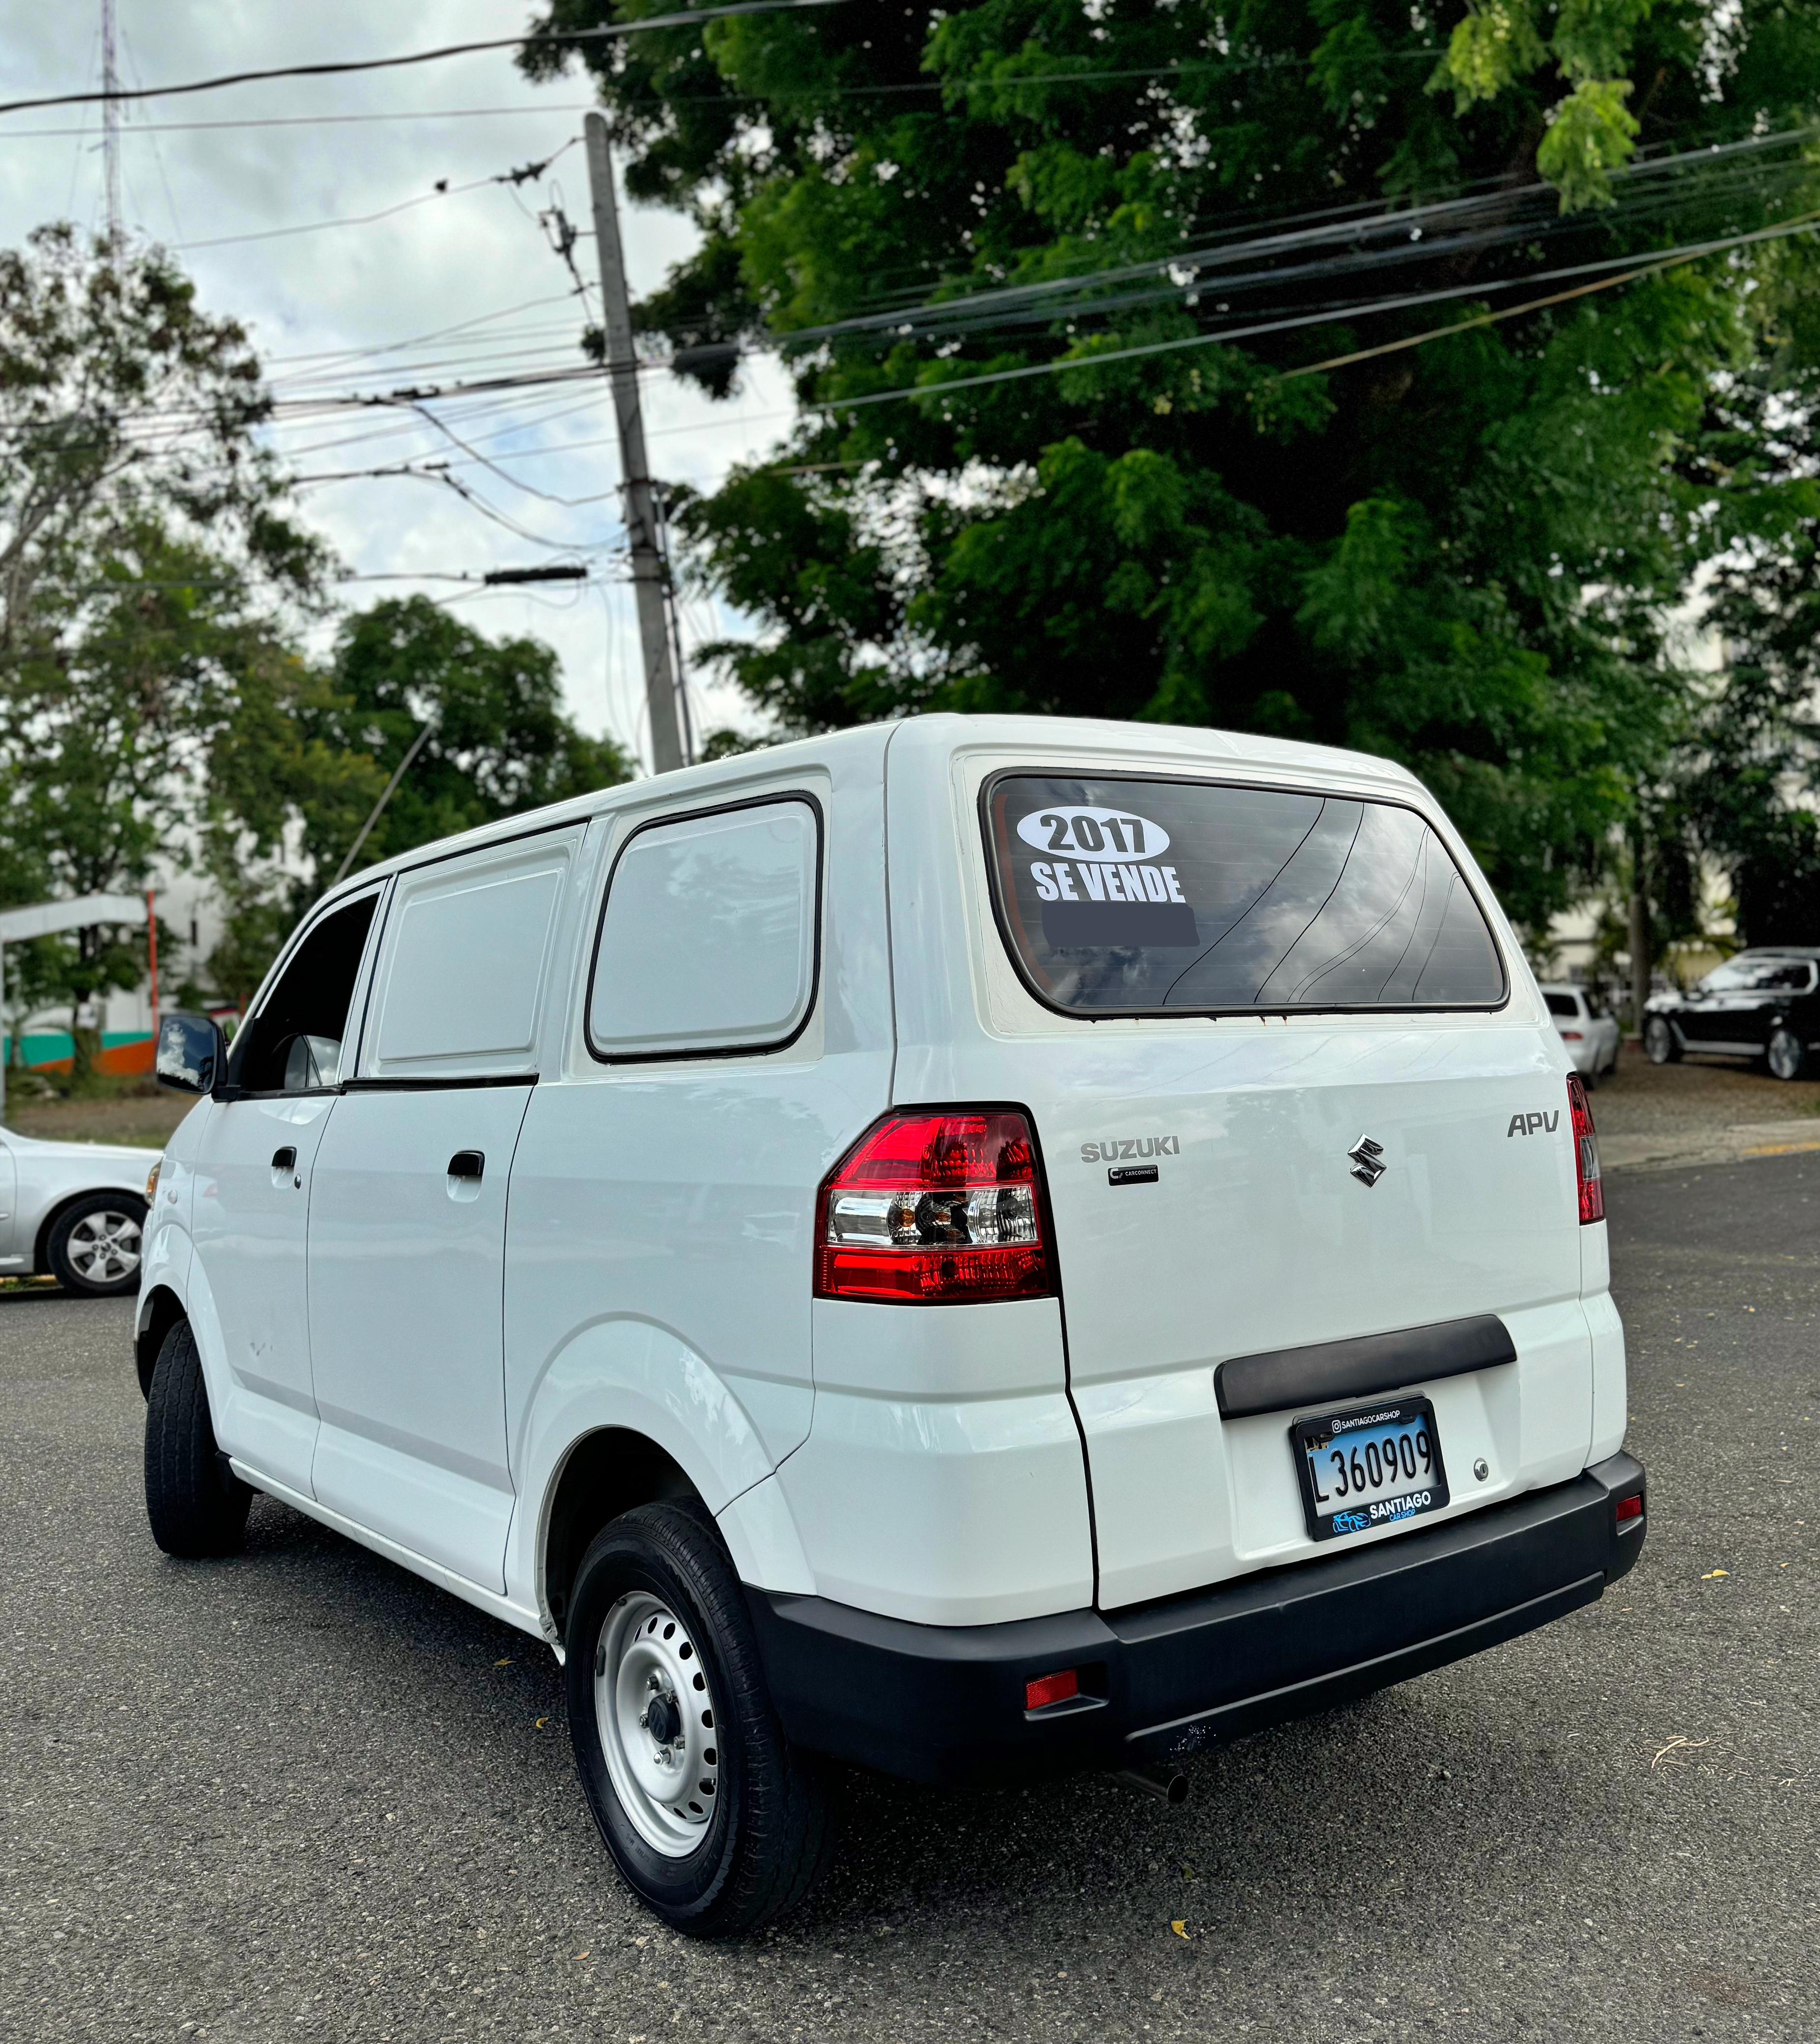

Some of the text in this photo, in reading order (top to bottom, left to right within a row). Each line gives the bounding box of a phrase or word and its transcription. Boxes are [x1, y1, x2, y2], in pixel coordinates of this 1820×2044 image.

[1040, 814, 1146, 853] 2017
[1030, 862, 1186, 903] SE VENDE
[1507, 1110, 1559, 1137] APV
[1081, 1136, 1180, 1163] SUZUKI
[1341, 1410, 1400, 1429] SANTIAGOCARSHOP
[1369, 1491, 1431, 1519] SANTIAGO
[1389, 1508, 1416, 1522] CAR SHOP
